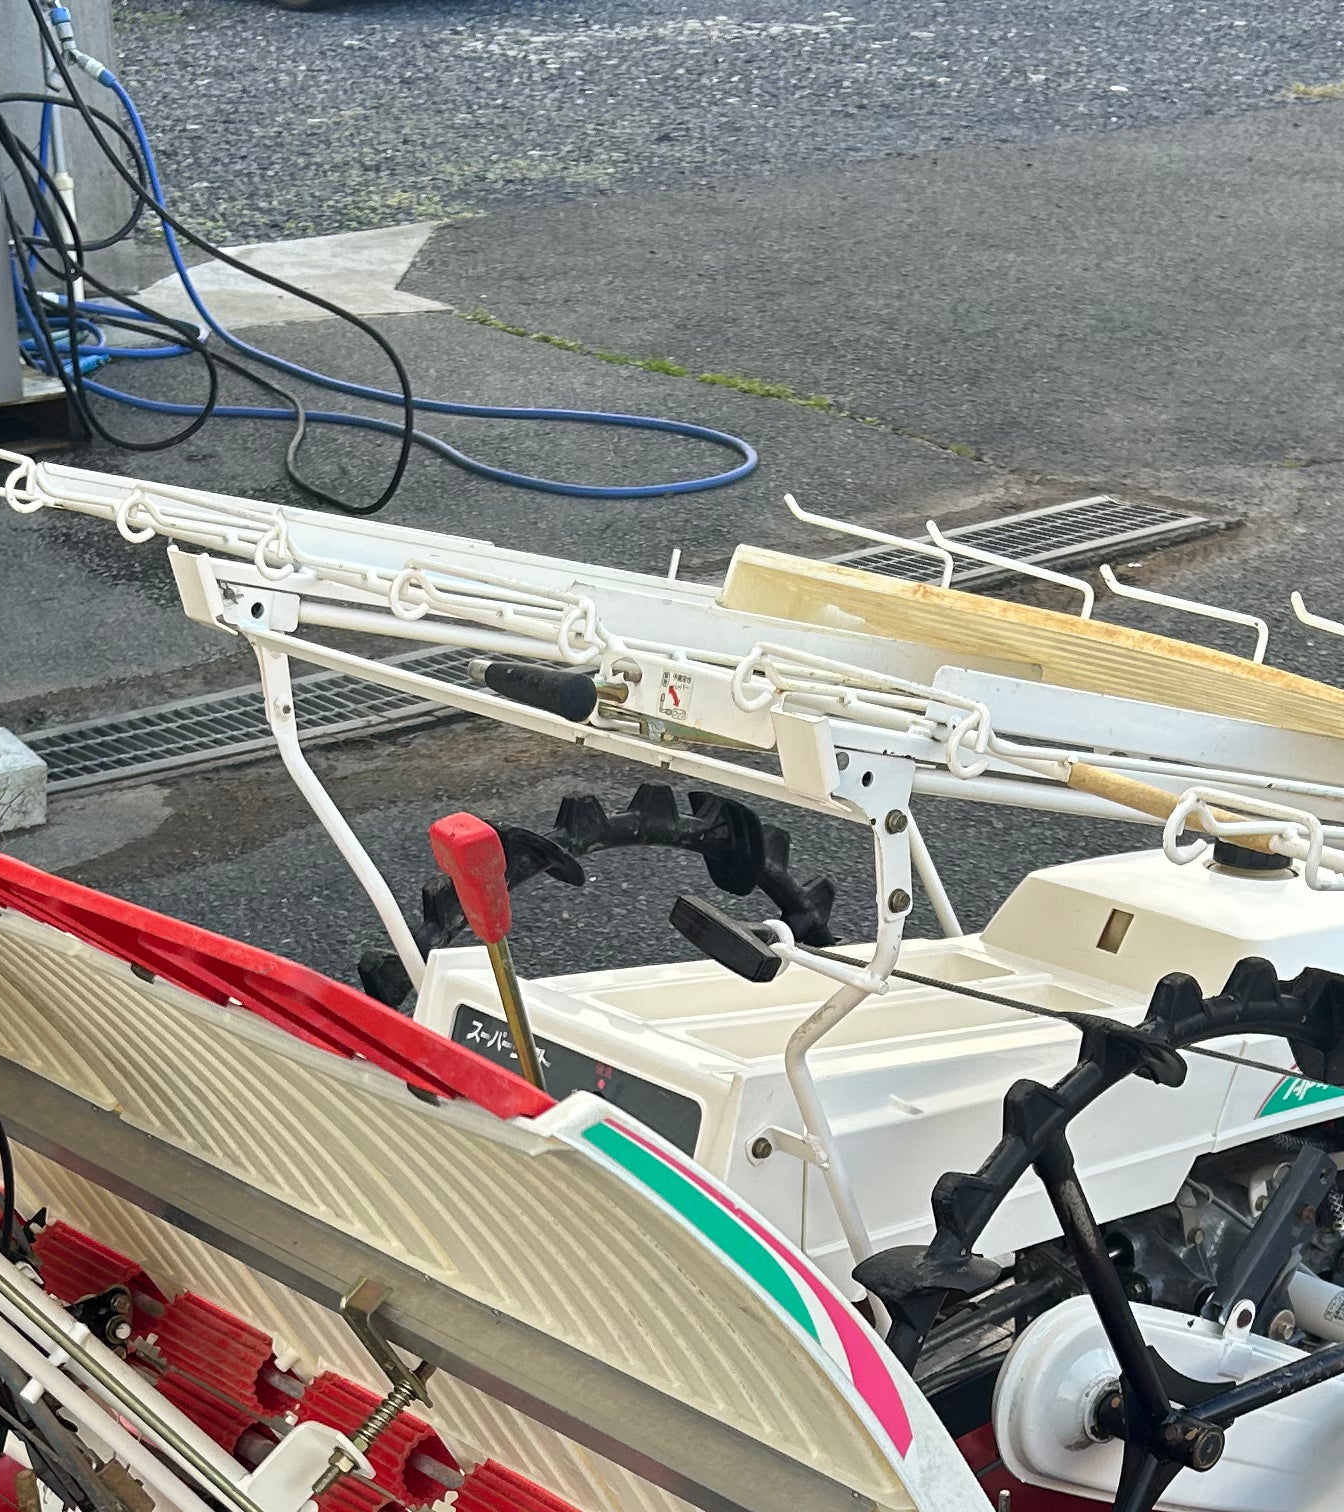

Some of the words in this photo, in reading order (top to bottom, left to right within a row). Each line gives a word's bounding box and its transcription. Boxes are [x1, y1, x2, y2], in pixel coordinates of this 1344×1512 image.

[465, 1020, 552, 1068] スーパース
